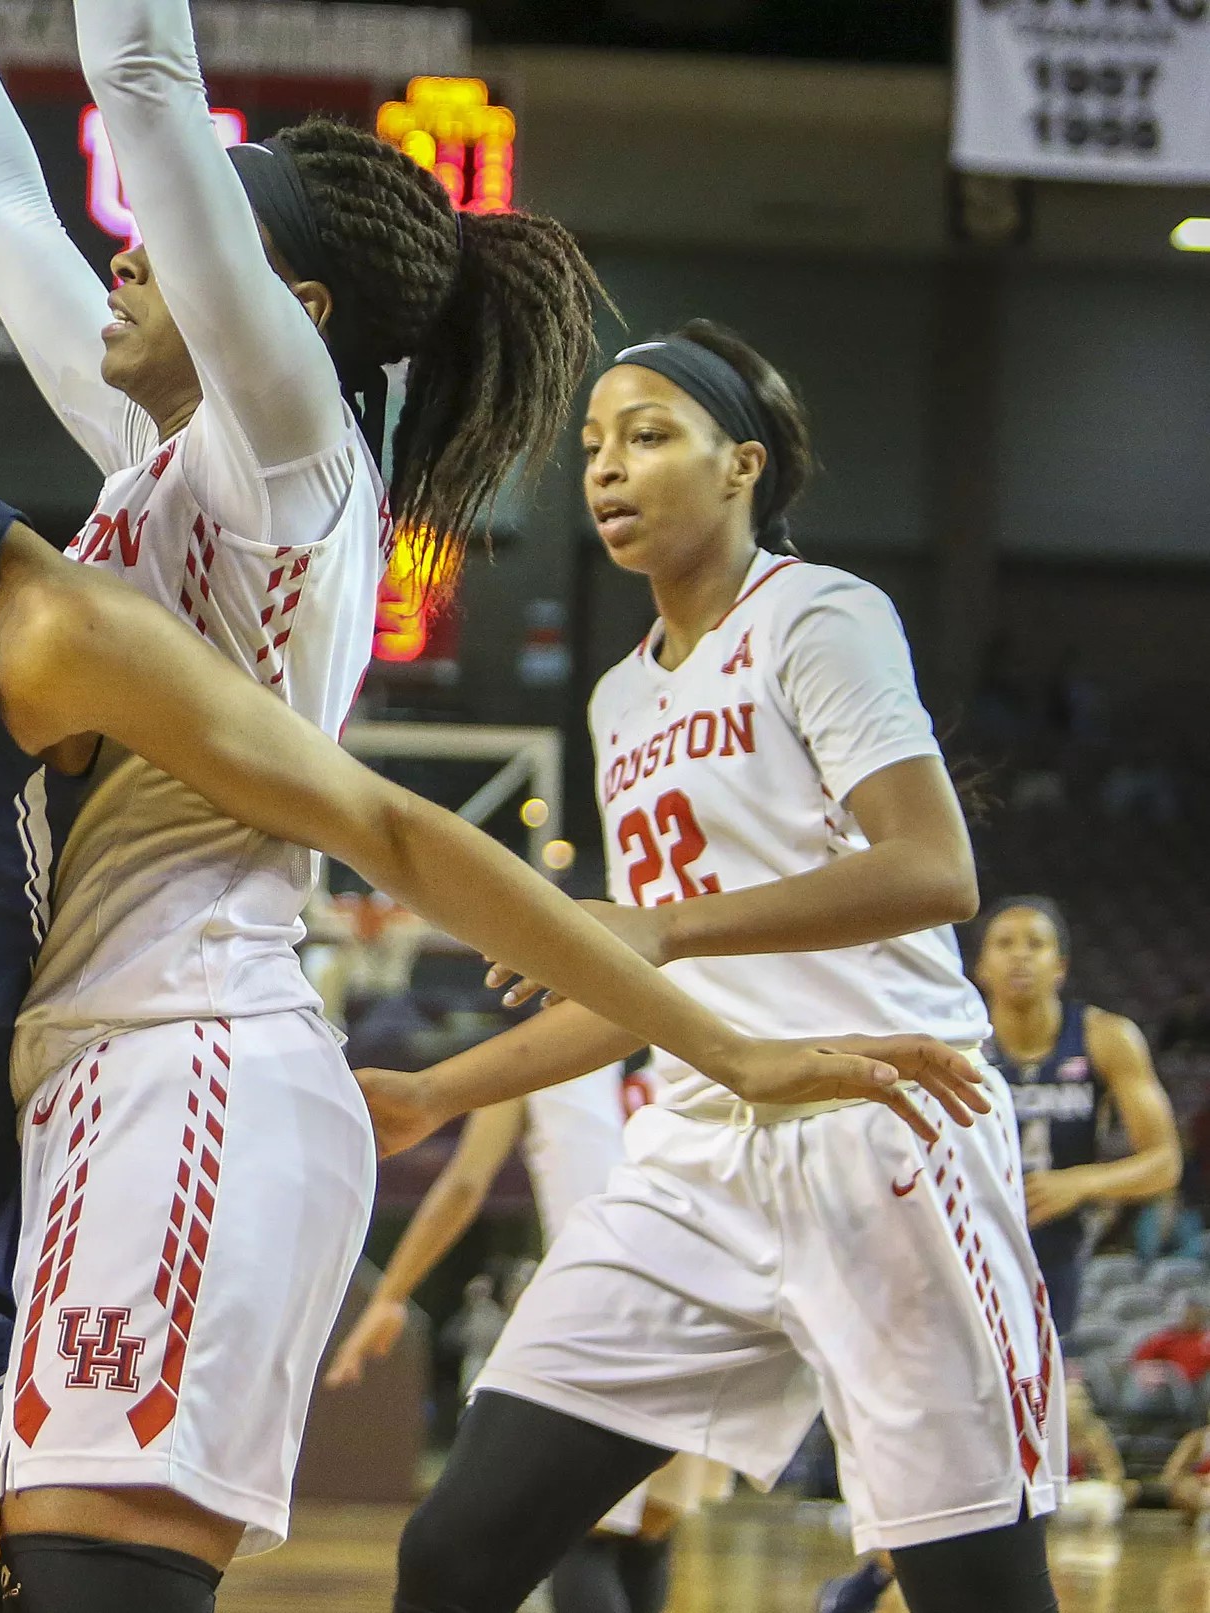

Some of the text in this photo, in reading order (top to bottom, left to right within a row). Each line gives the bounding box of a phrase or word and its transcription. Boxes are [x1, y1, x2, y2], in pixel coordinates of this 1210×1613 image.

[605, 702, 756, 805] OUSTON
[618, 787, 722, 908] 22
[57, 1306, 147, 1393] UH
